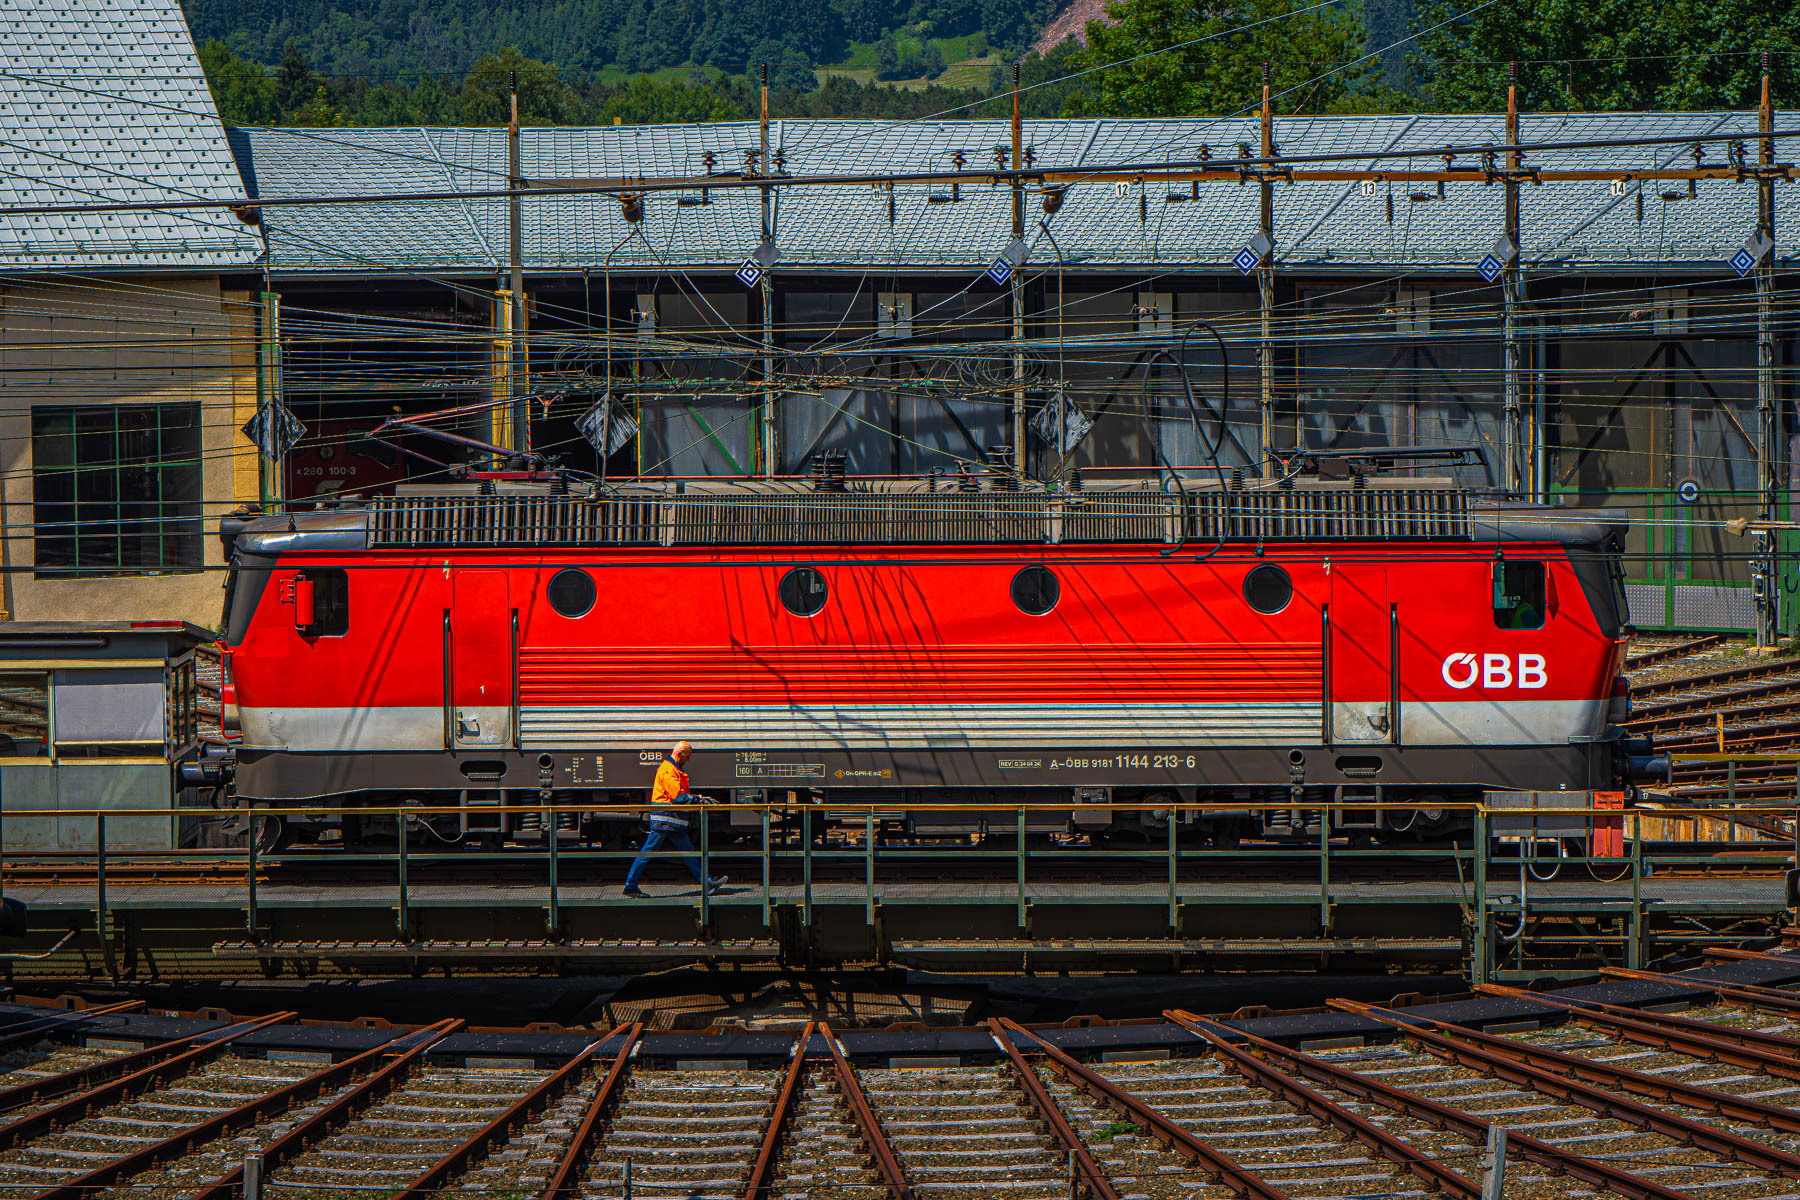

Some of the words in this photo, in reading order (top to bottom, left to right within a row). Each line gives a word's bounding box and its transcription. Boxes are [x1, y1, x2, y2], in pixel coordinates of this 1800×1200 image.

[1116, 184, 1128, 196] 12
[1362, 183, 1374, 195] 13
[1612, 182, 1625, 194] 14
[329, 466, 356, 475] 100-3
[1441, 652, 1548, 690] ÖBB
[479, 685, 485, 694] 1
[639, 750, 663, 761] ÖBB
[1049, 757, 1089, 769] A-ÖBB
[1091, 759, 1113, 768] 9181
[1115, 754, 1149, 768] 1144
[1153, 754, 1196, 768] 213-6
[739, 767, 750, 775] 160
[757, 767, 763, 775] A
